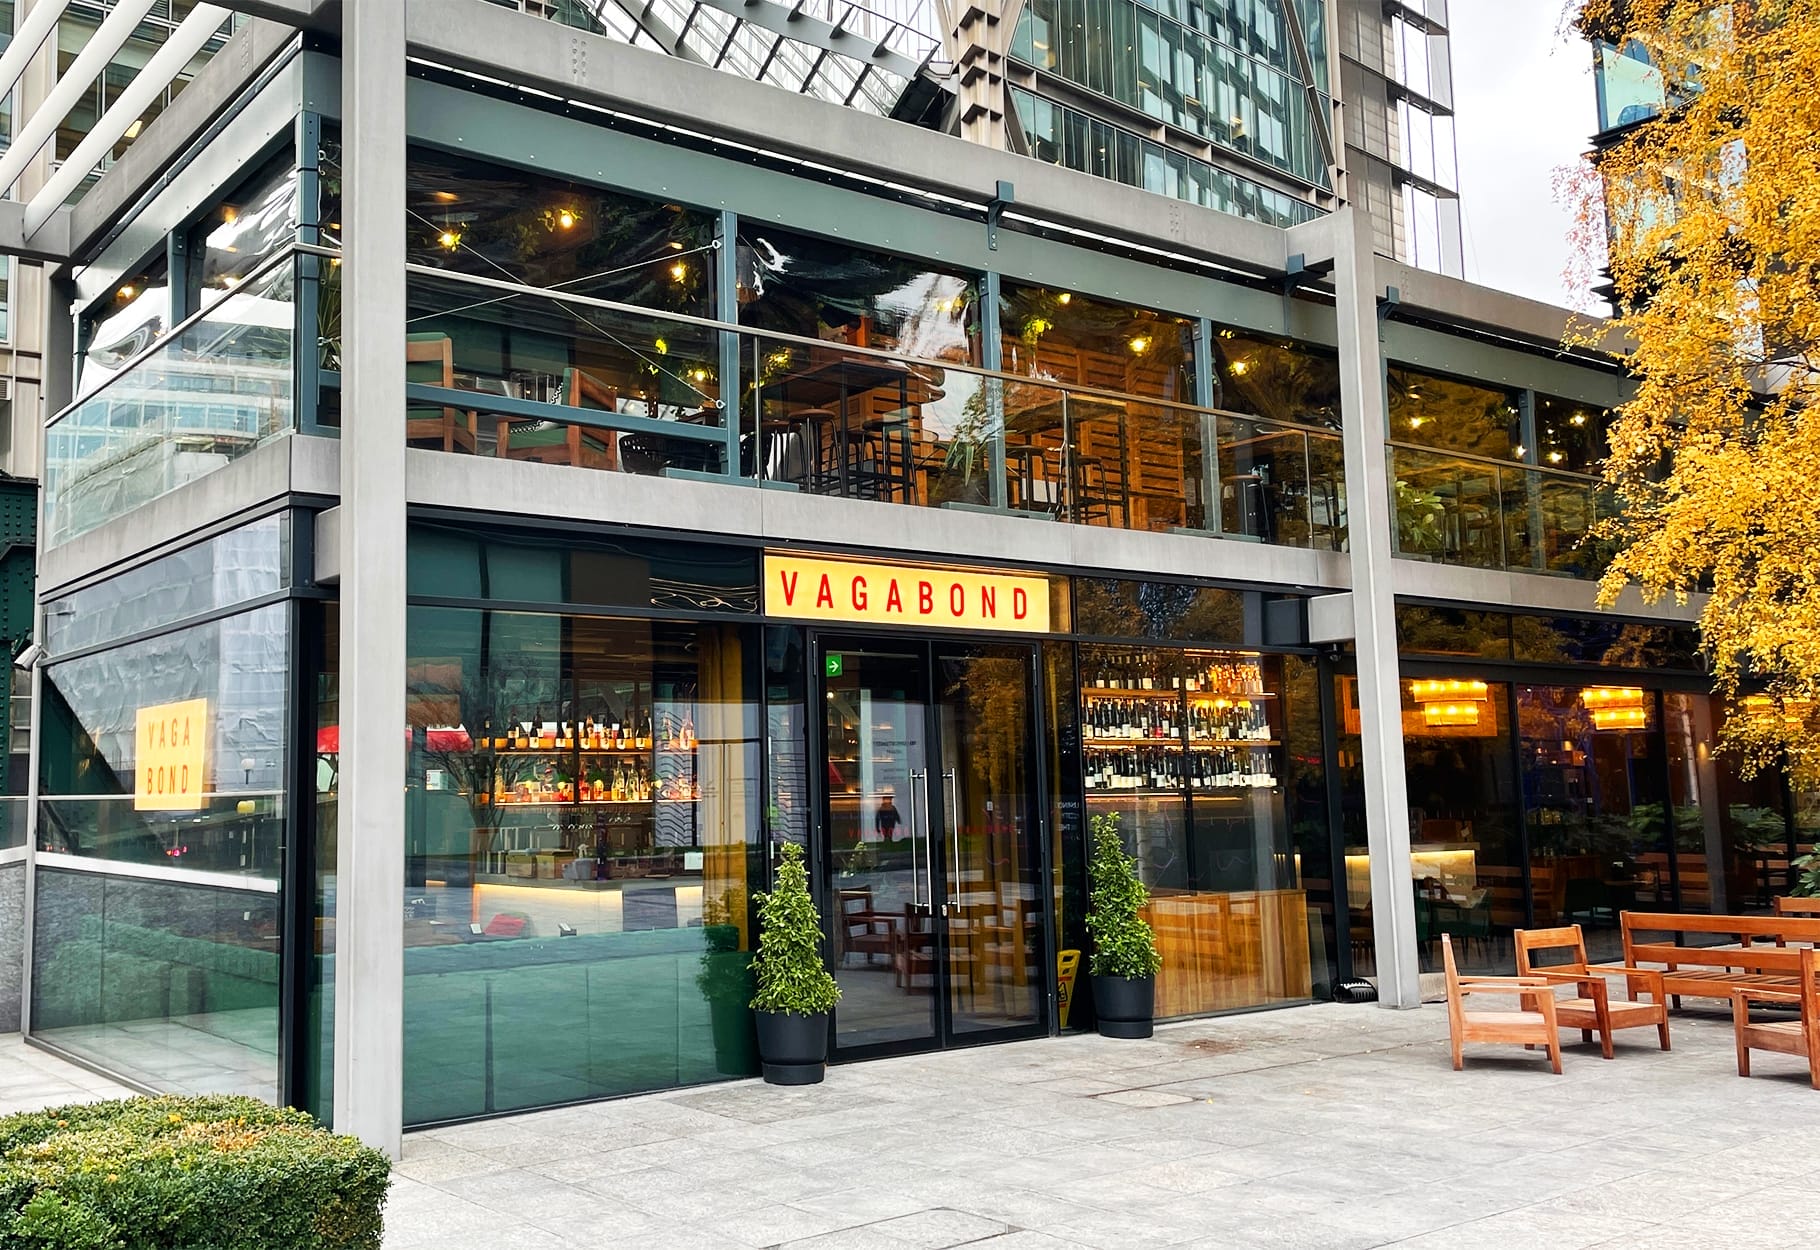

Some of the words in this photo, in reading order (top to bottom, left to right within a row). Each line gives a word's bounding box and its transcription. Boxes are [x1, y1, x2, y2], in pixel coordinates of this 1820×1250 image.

[780, 570, 1027, 619] VAGABOND
[148, 716, 190, 749] VAGA
[147, 764, 188, 795] BOND
